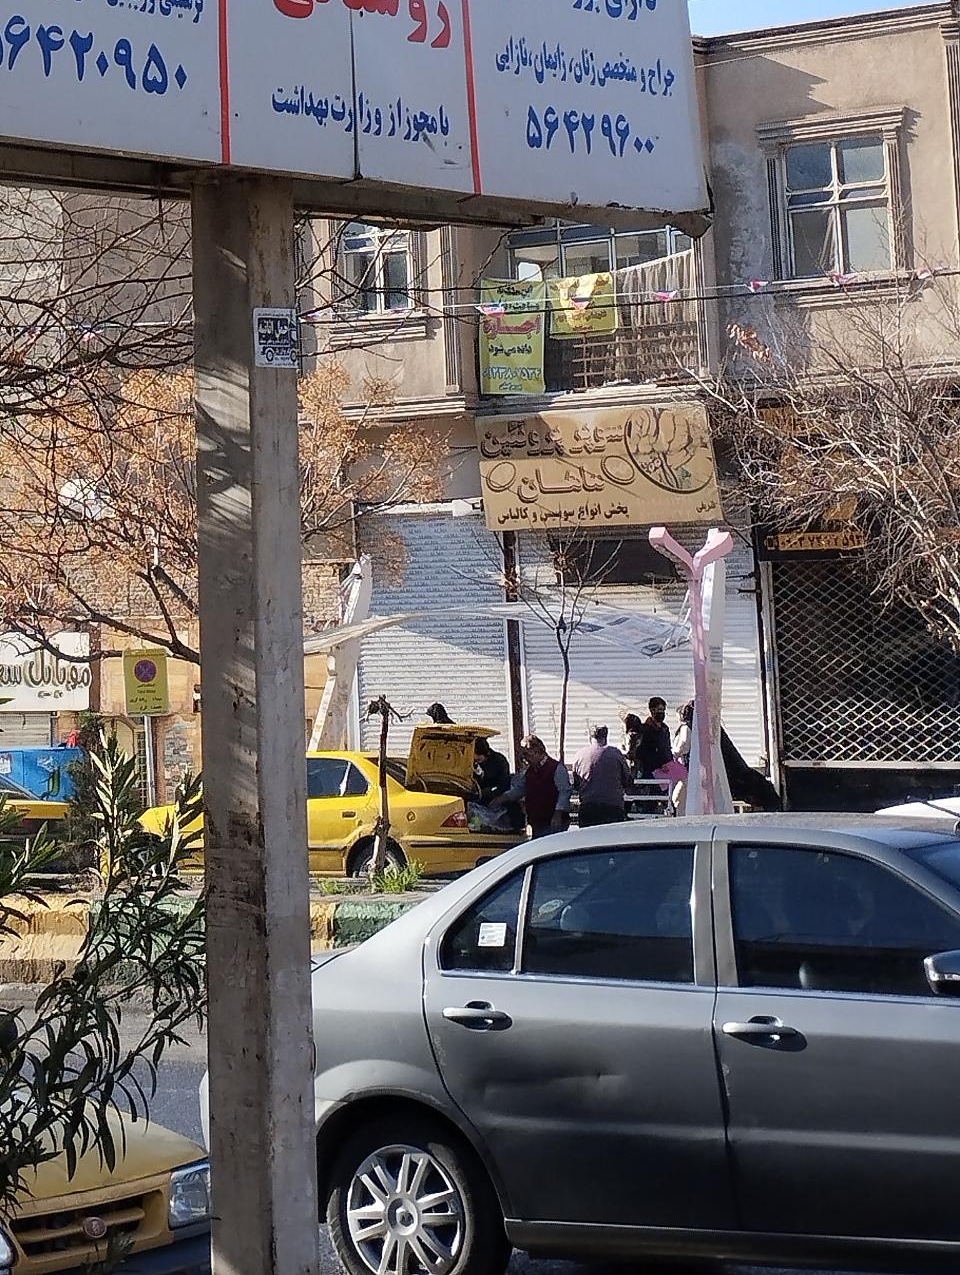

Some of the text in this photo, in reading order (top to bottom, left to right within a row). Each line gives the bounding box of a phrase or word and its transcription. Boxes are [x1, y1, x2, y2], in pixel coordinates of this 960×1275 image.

[496, 35, 527, 75] نازایی
[598, 52, 638, 87] متخصص
[641, 68, 647, 93] و
[648, 58, 675, 96] جراح
[272, 85, 449, 146] با مجوز از وزارت بهداشت
[526, 105, 655, 158] ۵۶۴۲۹۶۰۰
[604, 503, 628, 519] پخش
